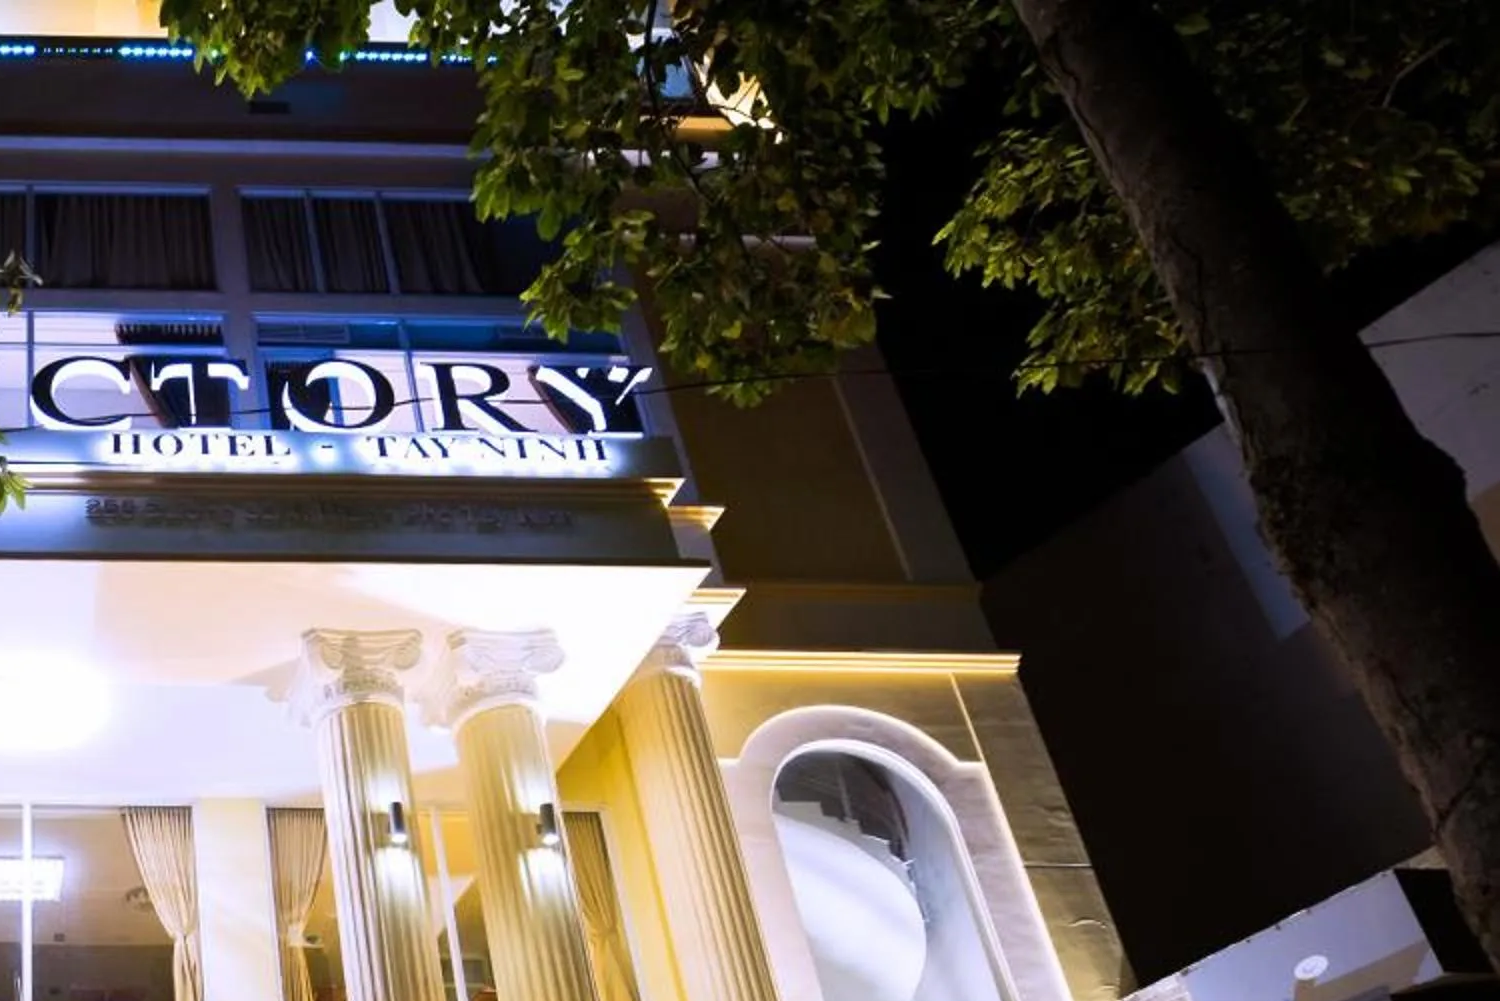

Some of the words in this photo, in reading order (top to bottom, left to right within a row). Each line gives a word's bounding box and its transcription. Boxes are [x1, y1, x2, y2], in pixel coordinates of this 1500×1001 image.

[110, 432, 292, 457] HOTEL
[365, 434, 458, 460] TAY
[476, 437, 609, 462] NINH
